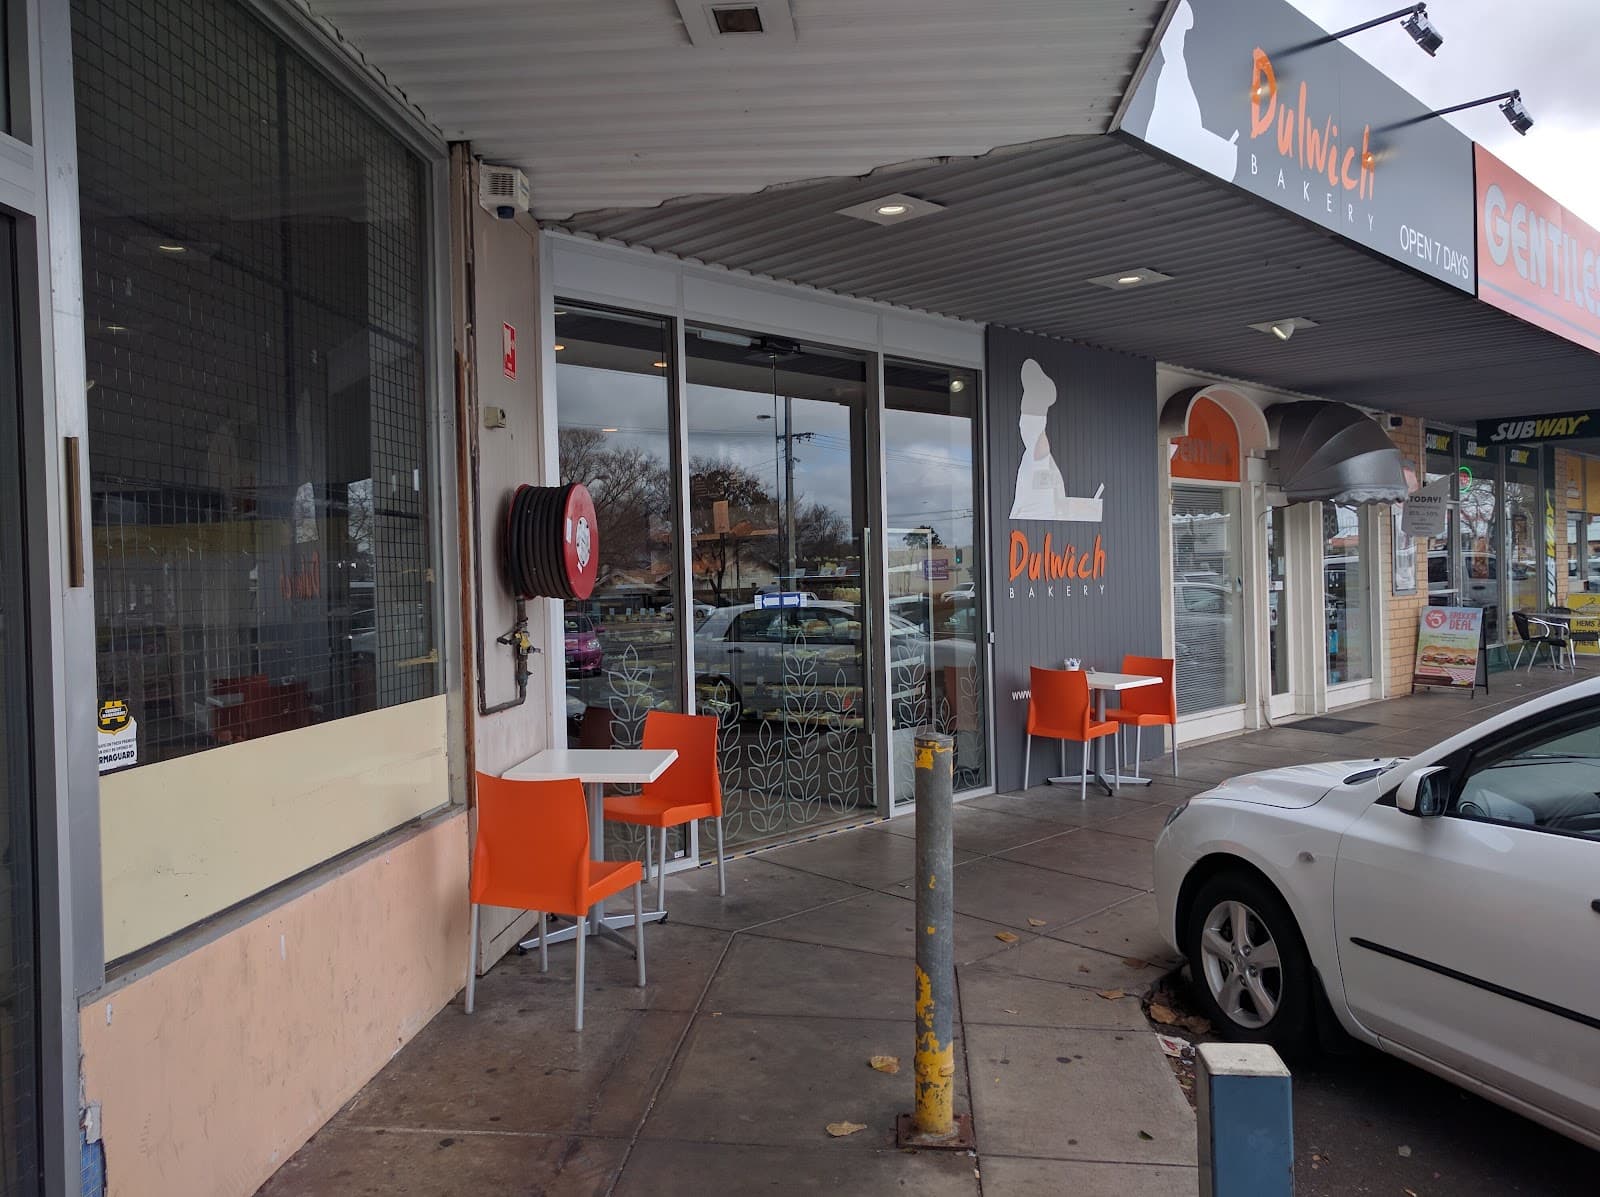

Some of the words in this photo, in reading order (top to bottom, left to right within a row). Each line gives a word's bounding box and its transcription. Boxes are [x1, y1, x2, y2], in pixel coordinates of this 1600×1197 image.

[1250, 46, 1376, 201] Dulwich
[1251, 153, 1375, 232] BAKERY
[1400, 224, 1433, 264] OPEN
[1434, 241, 1442, 266] 7
[1443, 245, 1469, 280] DAYS
[1426, 433, 1450, 451] SUBWAY
[1490, 414, 1591, 443] SUBWAY
[1008, 530, 1106, 582] Dulwich
[1009, 584, 1105, 599] BAKERY
